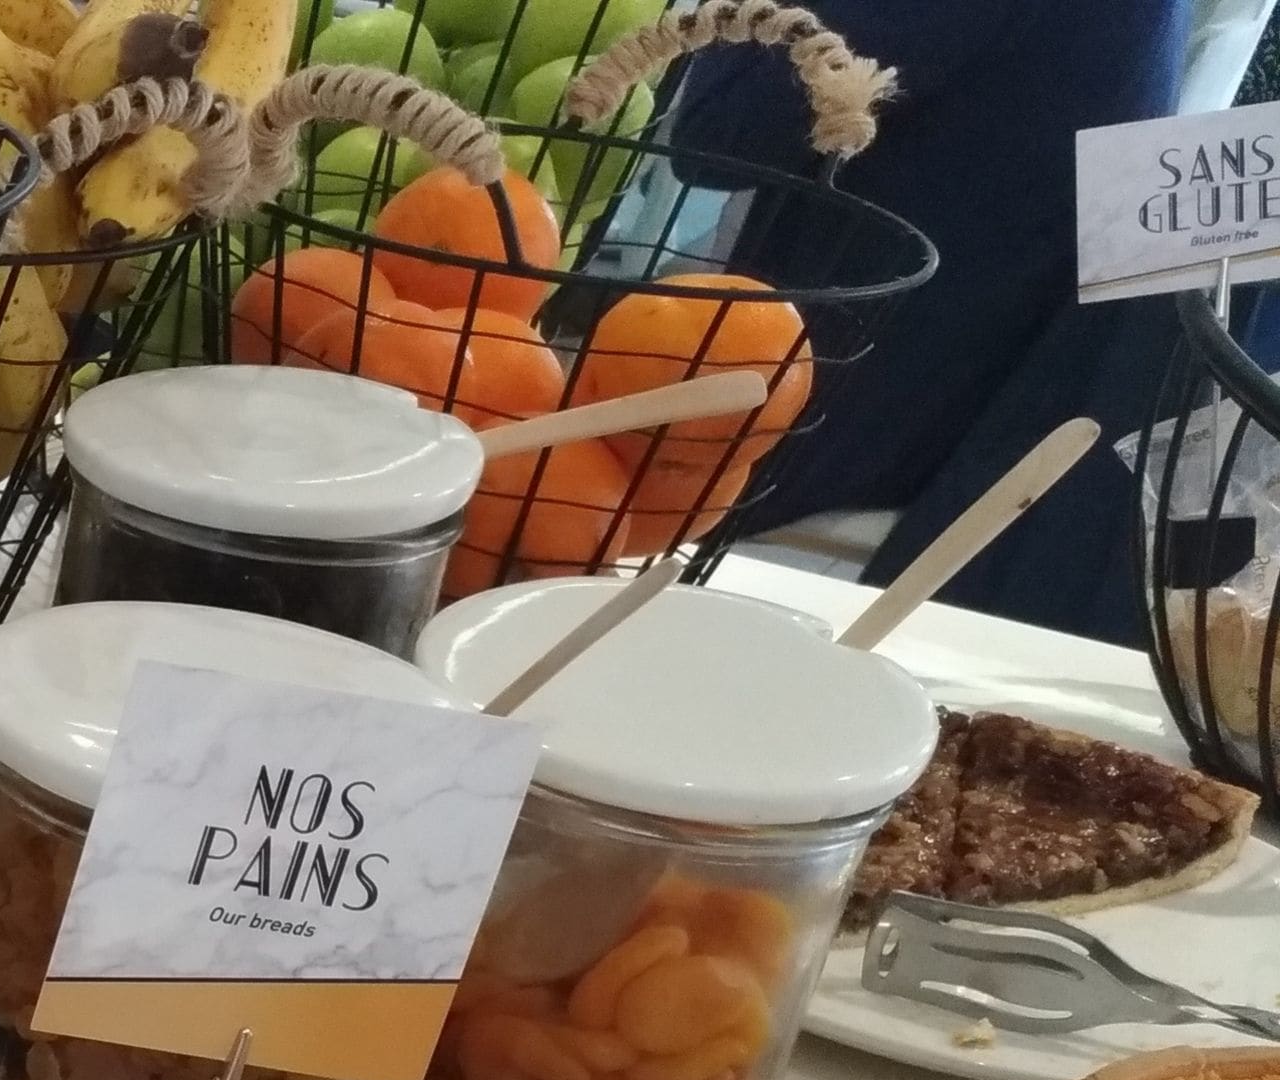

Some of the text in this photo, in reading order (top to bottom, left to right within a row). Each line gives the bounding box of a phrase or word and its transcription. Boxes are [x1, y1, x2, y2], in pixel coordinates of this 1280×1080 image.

[1158, 134, 1276, 190] SANS
[1138, 177, 1280, 234] GLUTE
[1190, 229, 1259, 247] Gluten free
[244, 764, 377, 841] NOS
[187, 825, 391, 912] PAINS
[208, 906, 317, 938] Our breads
